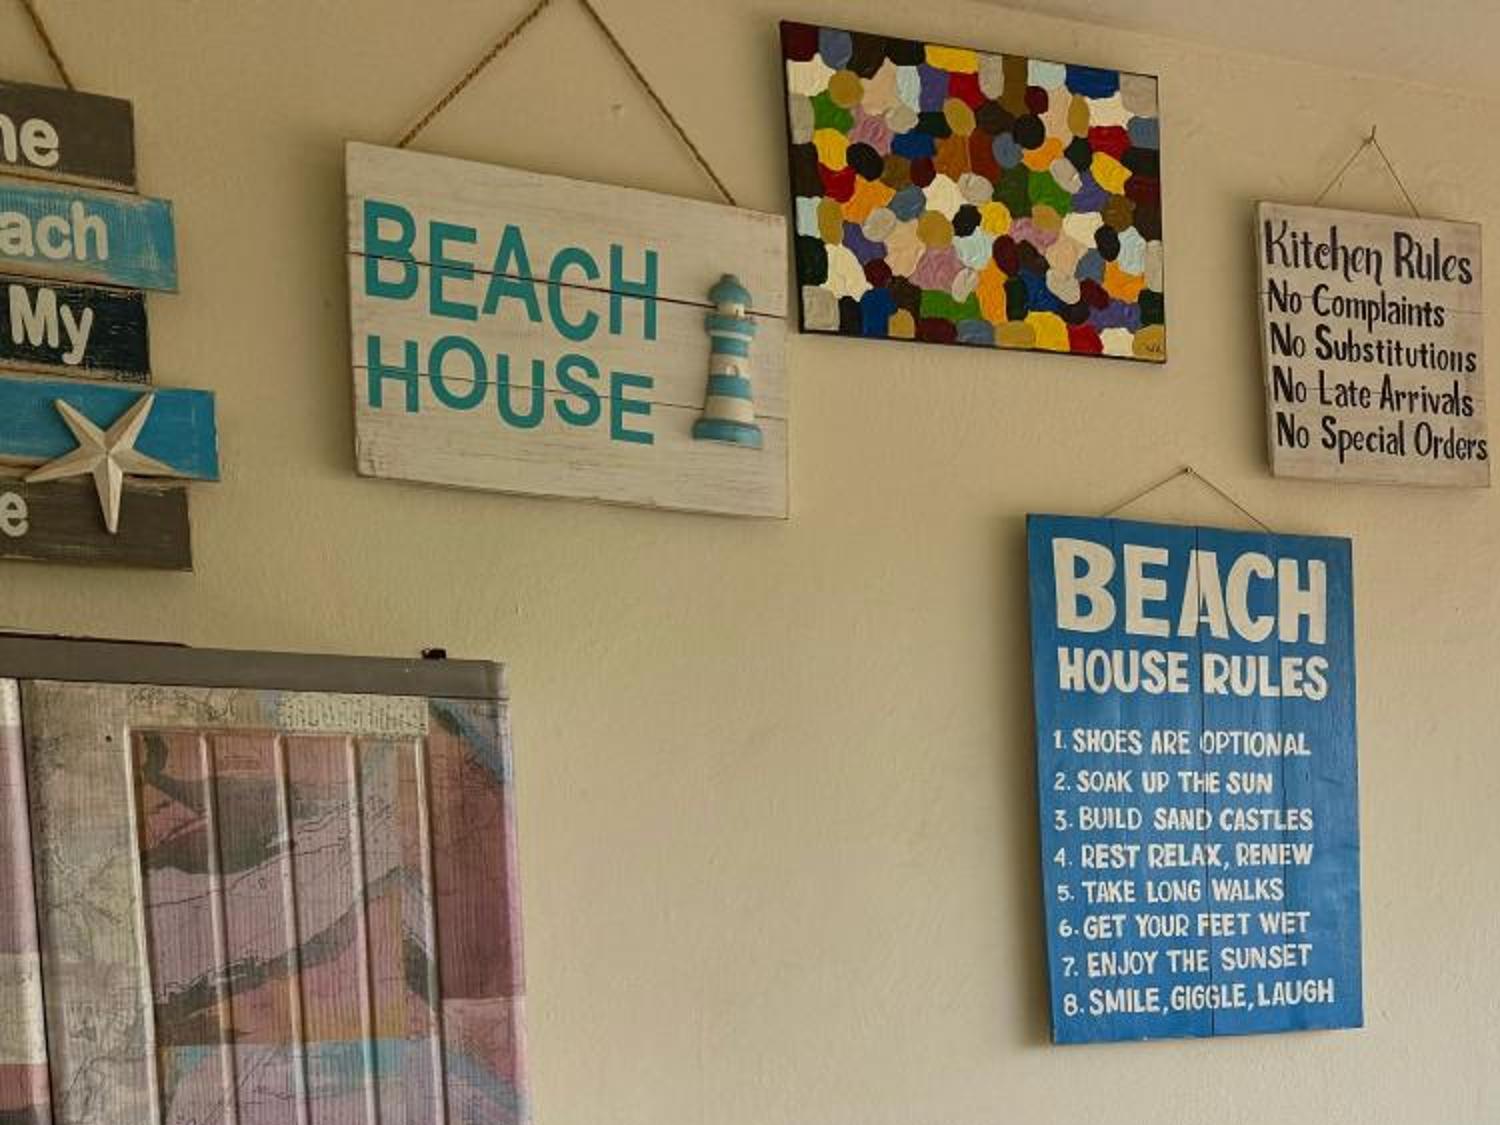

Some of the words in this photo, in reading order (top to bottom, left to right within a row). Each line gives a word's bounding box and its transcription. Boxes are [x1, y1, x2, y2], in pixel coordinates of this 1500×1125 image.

[364, 199, 658, 343] BEACH
[1265, 220, 1382, 285] Kitchen
[1394, 231, 1472, 284] Rules
[9, 285, 93, 364] My
[1268, 278, 1302, 314] No
[1313, 283, 1445, 332] Complaints
[1270, 322, 1305, 357] No
[1315, 324, 1476, 372] Substitutions
[367, 334, 654, 445] HOUSE
[1273, 366, 1306, 403] No
[1318, 370, 1371, 408] Late
[1380, 374, 1474, 417] Arrivals
[1276, 411, 1309, 449] No
[1322, 415, 1405, 464] Special
[1415, 421, 1488, 460] Orders
[1052, 538, 1326, 644] BEACH
[1057, 647, 1189, 695] HOUSE
[1203, 653, 1328, 701] RULES
[1054, 732, 1066, 749] 1.
[1073, 729, 1142, 754] SHOES
[1152, 731, 1190, 754] ARE
[1201, 732, 1312, 757] OPTIONAL
[1054, 775, 1071, 791] 2.
[1076, 771, 1133, 792] SOAK
[1142, 772, 1169, 792] UP
[1178, 772, 1220, 793] THE
[1226, 772, 1272, 794] SUN
[1054, 810, 1072, 830] 3.
[1080, 806, 1142, 829] BUILD
[1154, 808, 1212, 830] SAND
[1220, 808, 1313, 831] CASTLES
[1054, 849, 1072, 867] 4.
[1081, 844, 1139, 869] REST
[1149, 843, 1229, 870] RELAX,
[1236, 842, 1313, 865] RENEW
[1057, 885, 1074, 901] 5.
[1082, 881, 1135, 903] TAKE
[1147, 881, 1200, 902] LONG
[1212, 878, 1284, 901] WALKS
[1059, 920, 1079, 936] 6.
[1083, 915, 1126, 939] GET
[1136, 914, 1189, 938] YOUR
[1198, 913, 1250, 936] FEET
[1259, 911, 1310, 934] WET
[1062, 958, 1078, 976] 7.
[1087, 950, 1159, 977] ENJOY
[1166, 950, 1208, 972] THE
[1221, 944, 1312, 970] SUNSET
[1063, 994, 1084, 1015] 8.
[1089, 988, 1169, 1016] SMILE,
[1171, 984, 1254, 1011] GIGGLE,
[1258, 978, 1334, 1005] LAUGH
